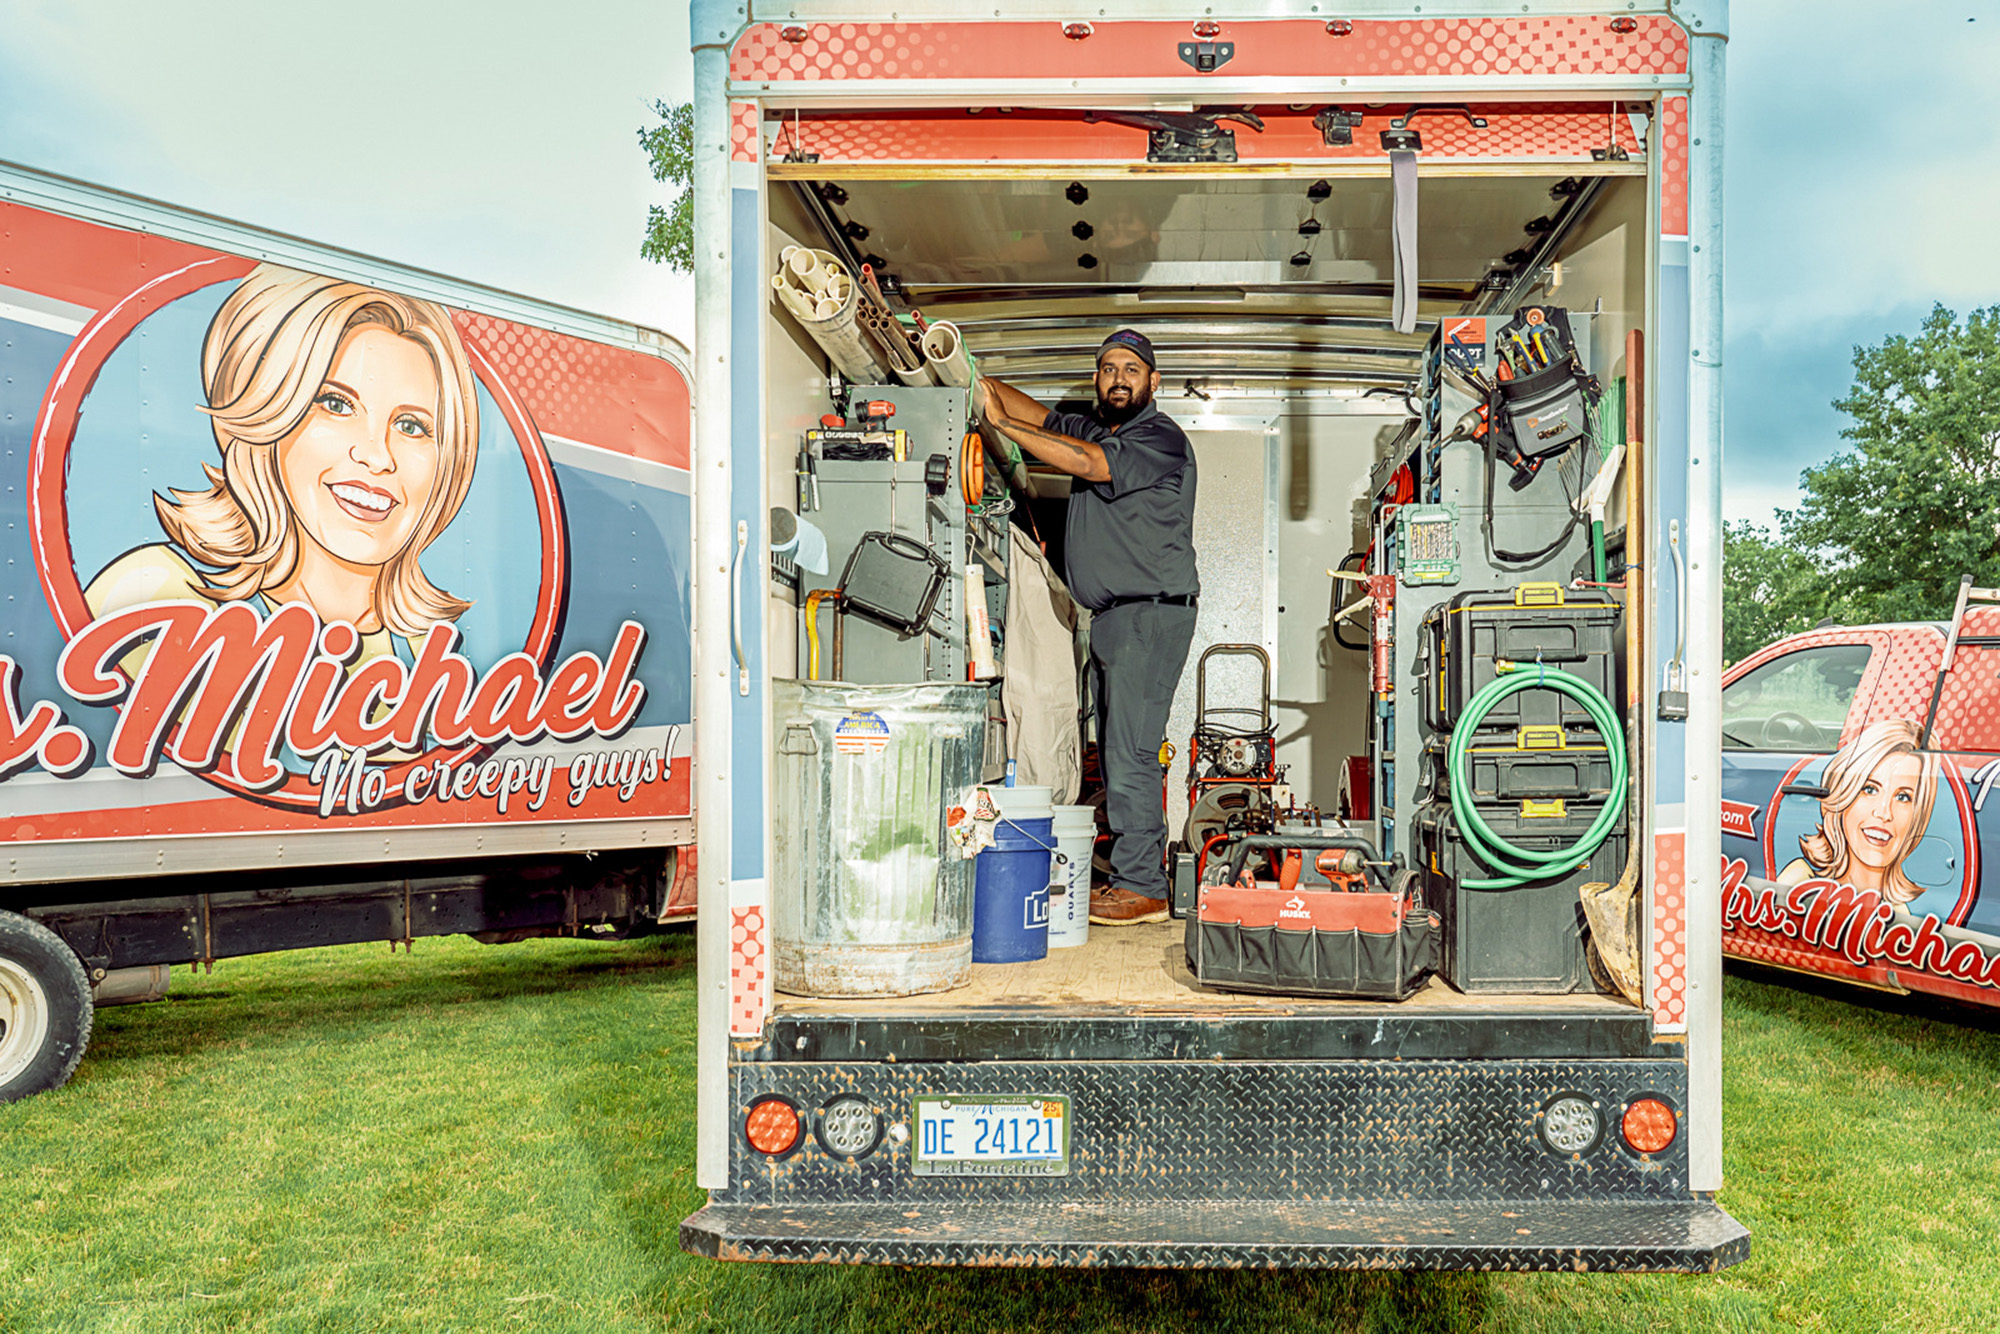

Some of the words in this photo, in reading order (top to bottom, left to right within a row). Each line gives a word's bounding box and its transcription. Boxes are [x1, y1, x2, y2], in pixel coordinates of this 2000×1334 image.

[57, 599, 647, 790] Michael
[310, 746, 386, 818] No
[403, 755, 555, 814] creepy
[569, 724, 682, 808] guys!
[1280, 909, 1310, 919] HUSKY
[1044, 1102, 1056, 1112] 25
[924, 1119, 954, 1154] DE
[975, 1118, 1058, 1154] 24121
[929, 1160, 1053, 1175] LaFontaine
